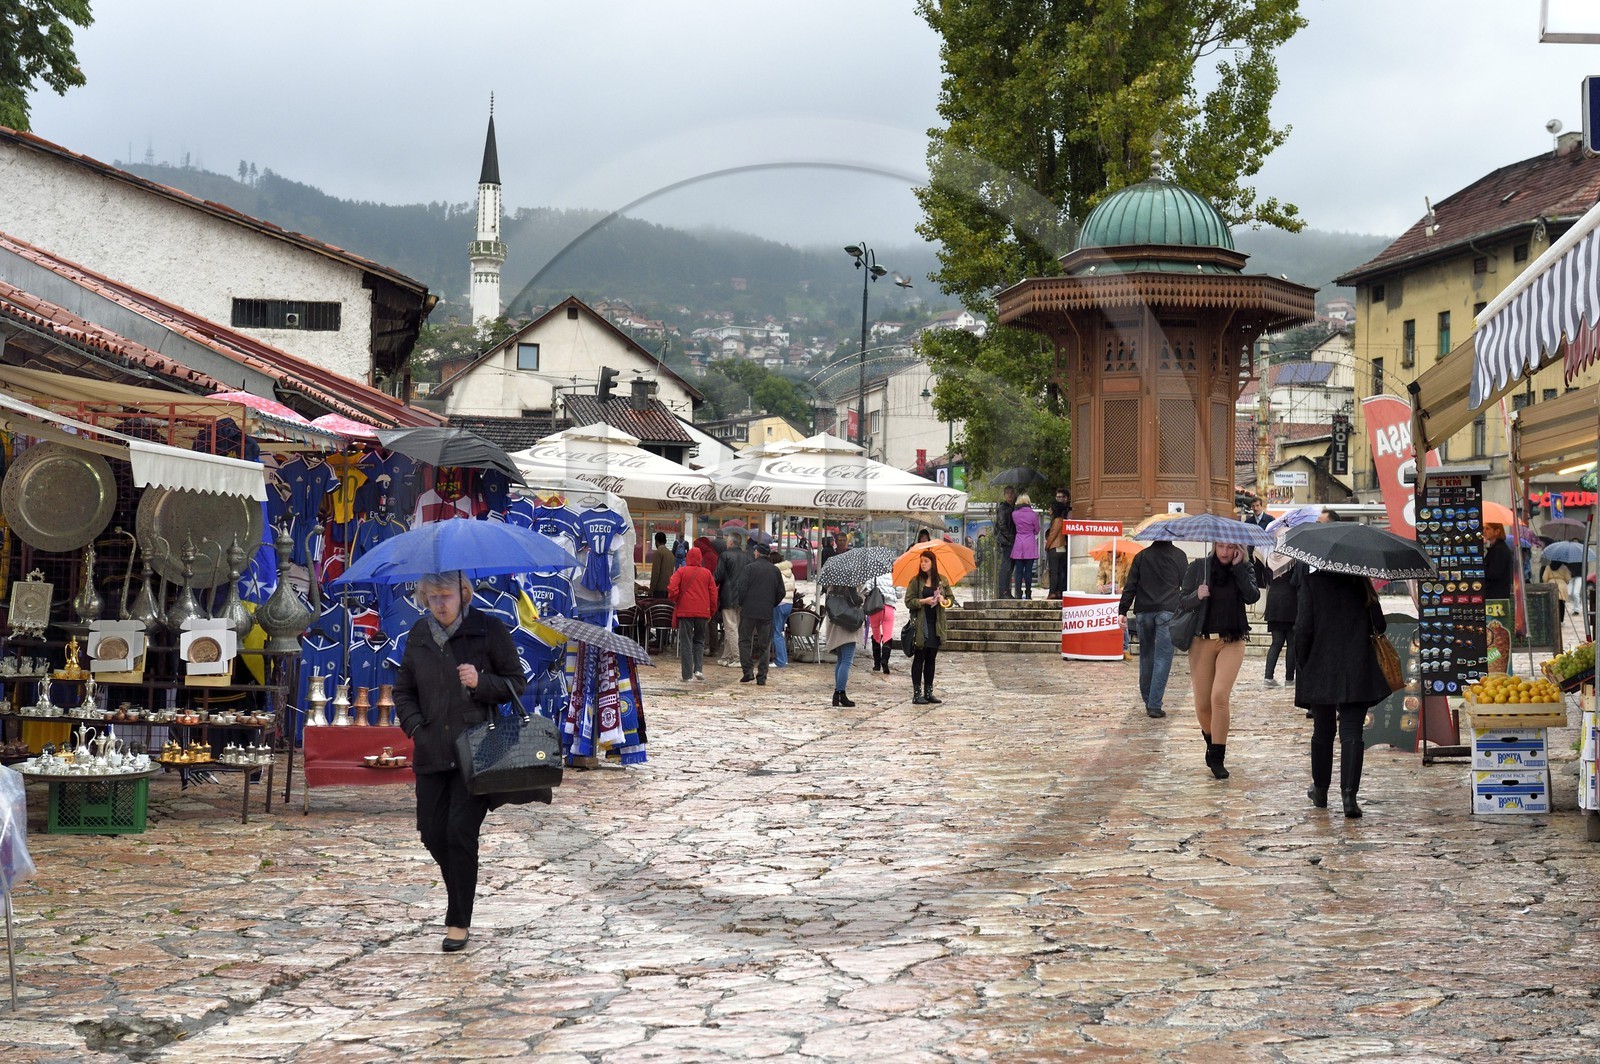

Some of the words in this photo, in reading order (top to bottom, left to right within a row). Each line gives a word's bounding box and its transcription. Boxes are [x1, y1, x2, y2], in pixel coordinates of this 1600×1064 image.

[1335, 422, 1345, 471] HOTEL
[1530, 491, 1598, 508] OZUM
[1066, 524, 1084, 532] NAŠA
[1085, 525, 1119, 533] STRANKA
[593, 535, 606, 554] 11
[1062, 620, 1085, 630] AMO
[1497, 753, 1523, 765] BONITA
[1499, 797, 1524, 809] BONITA
